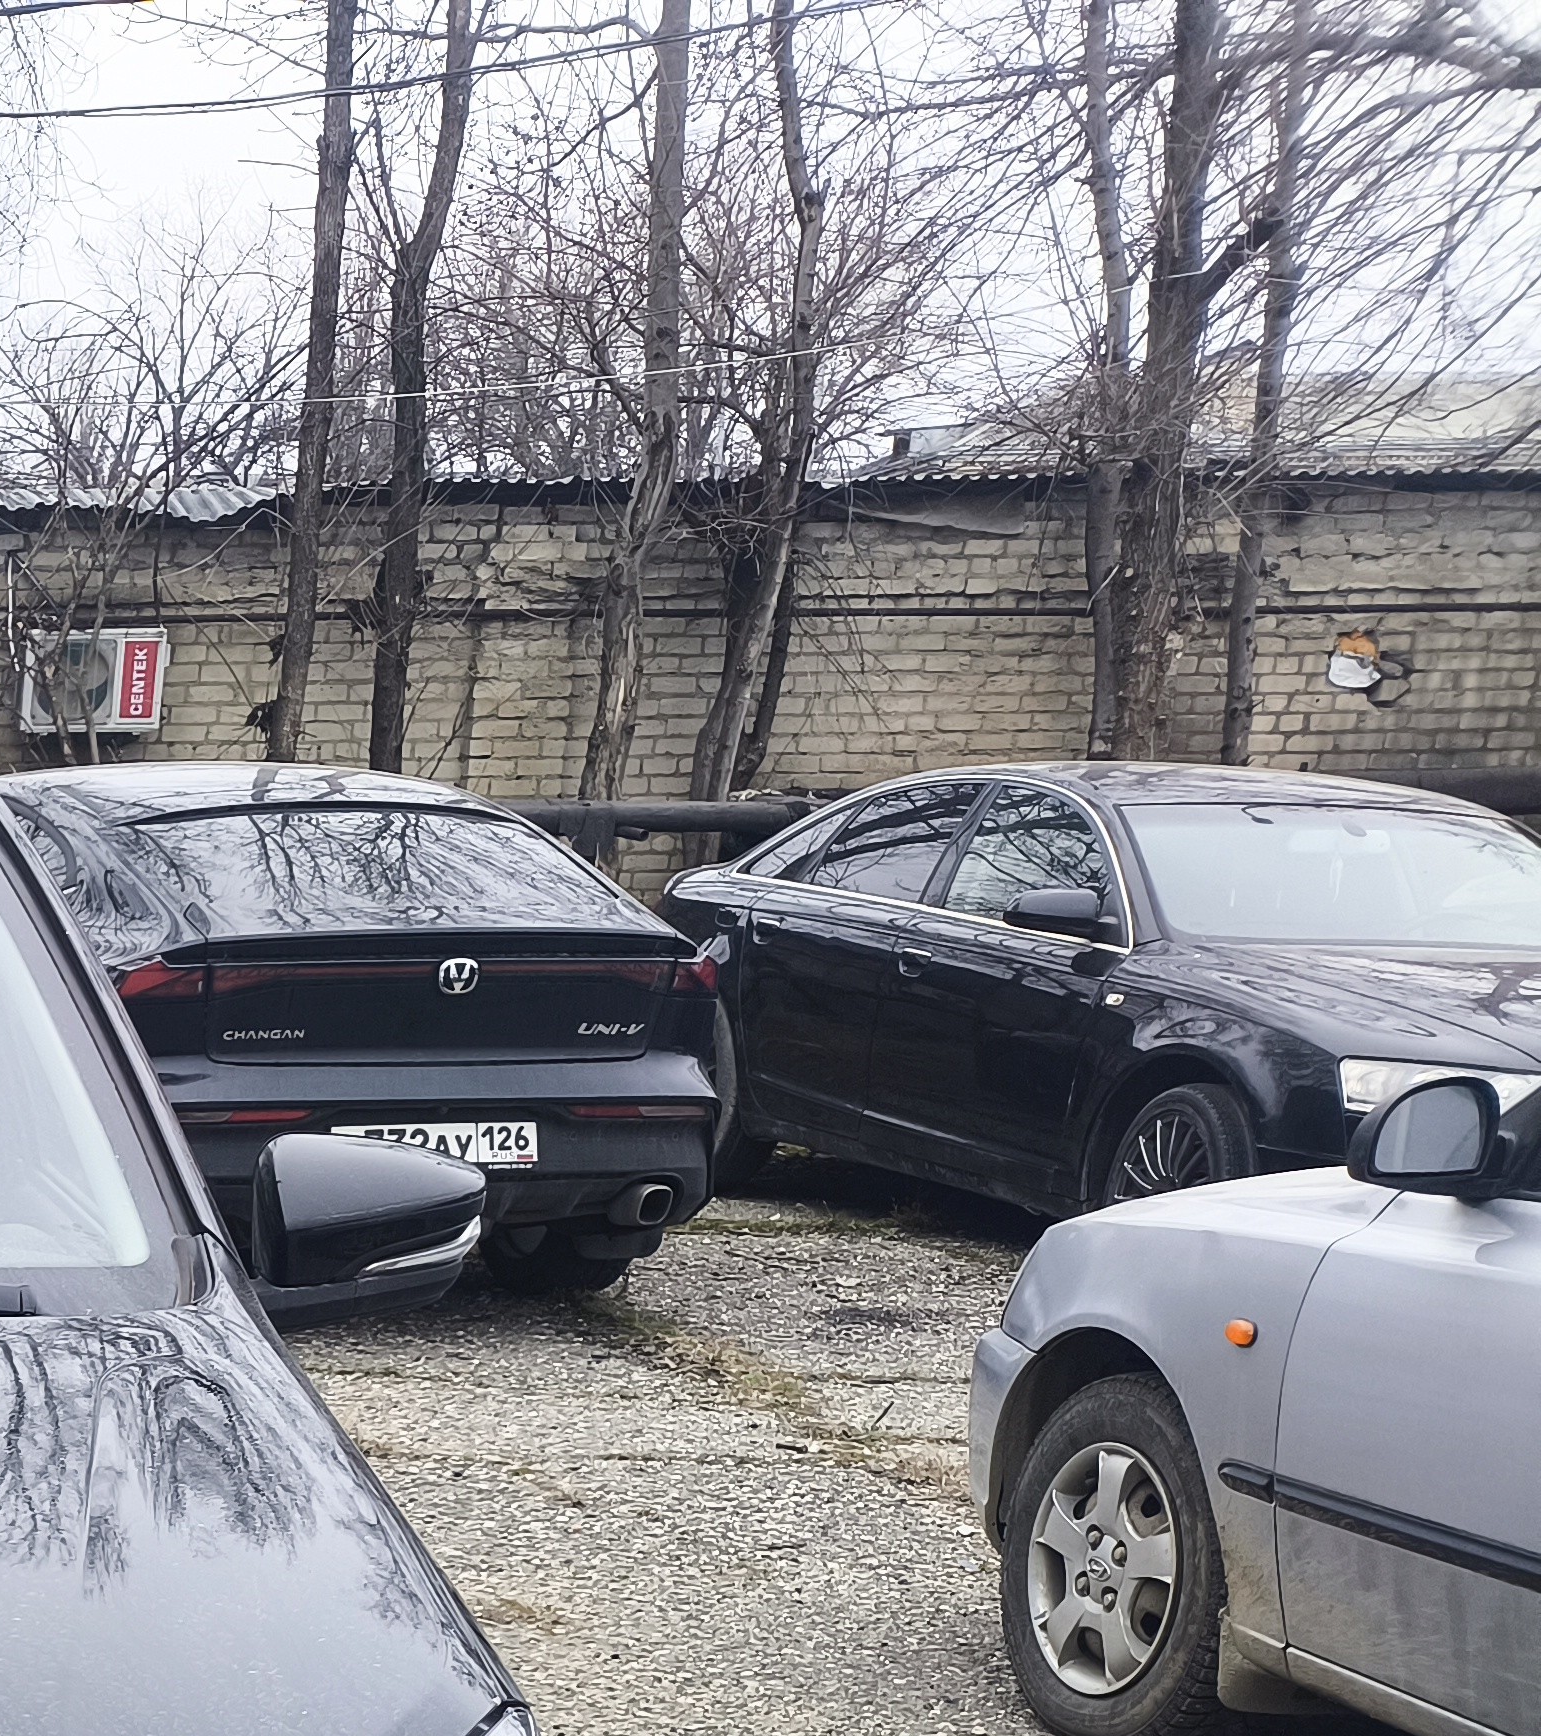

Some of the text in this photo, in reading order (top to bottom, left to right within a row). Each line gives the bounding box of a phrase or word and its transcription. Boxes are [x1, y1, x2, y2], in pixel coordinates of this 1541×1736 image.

[130, 648, 147, 715] CENTEK
[223, 1029, 305, 1040] CHANGAN
[578, 1023, 645, 1035] UNI-V
[481, 1126, 530, 1151] 126
